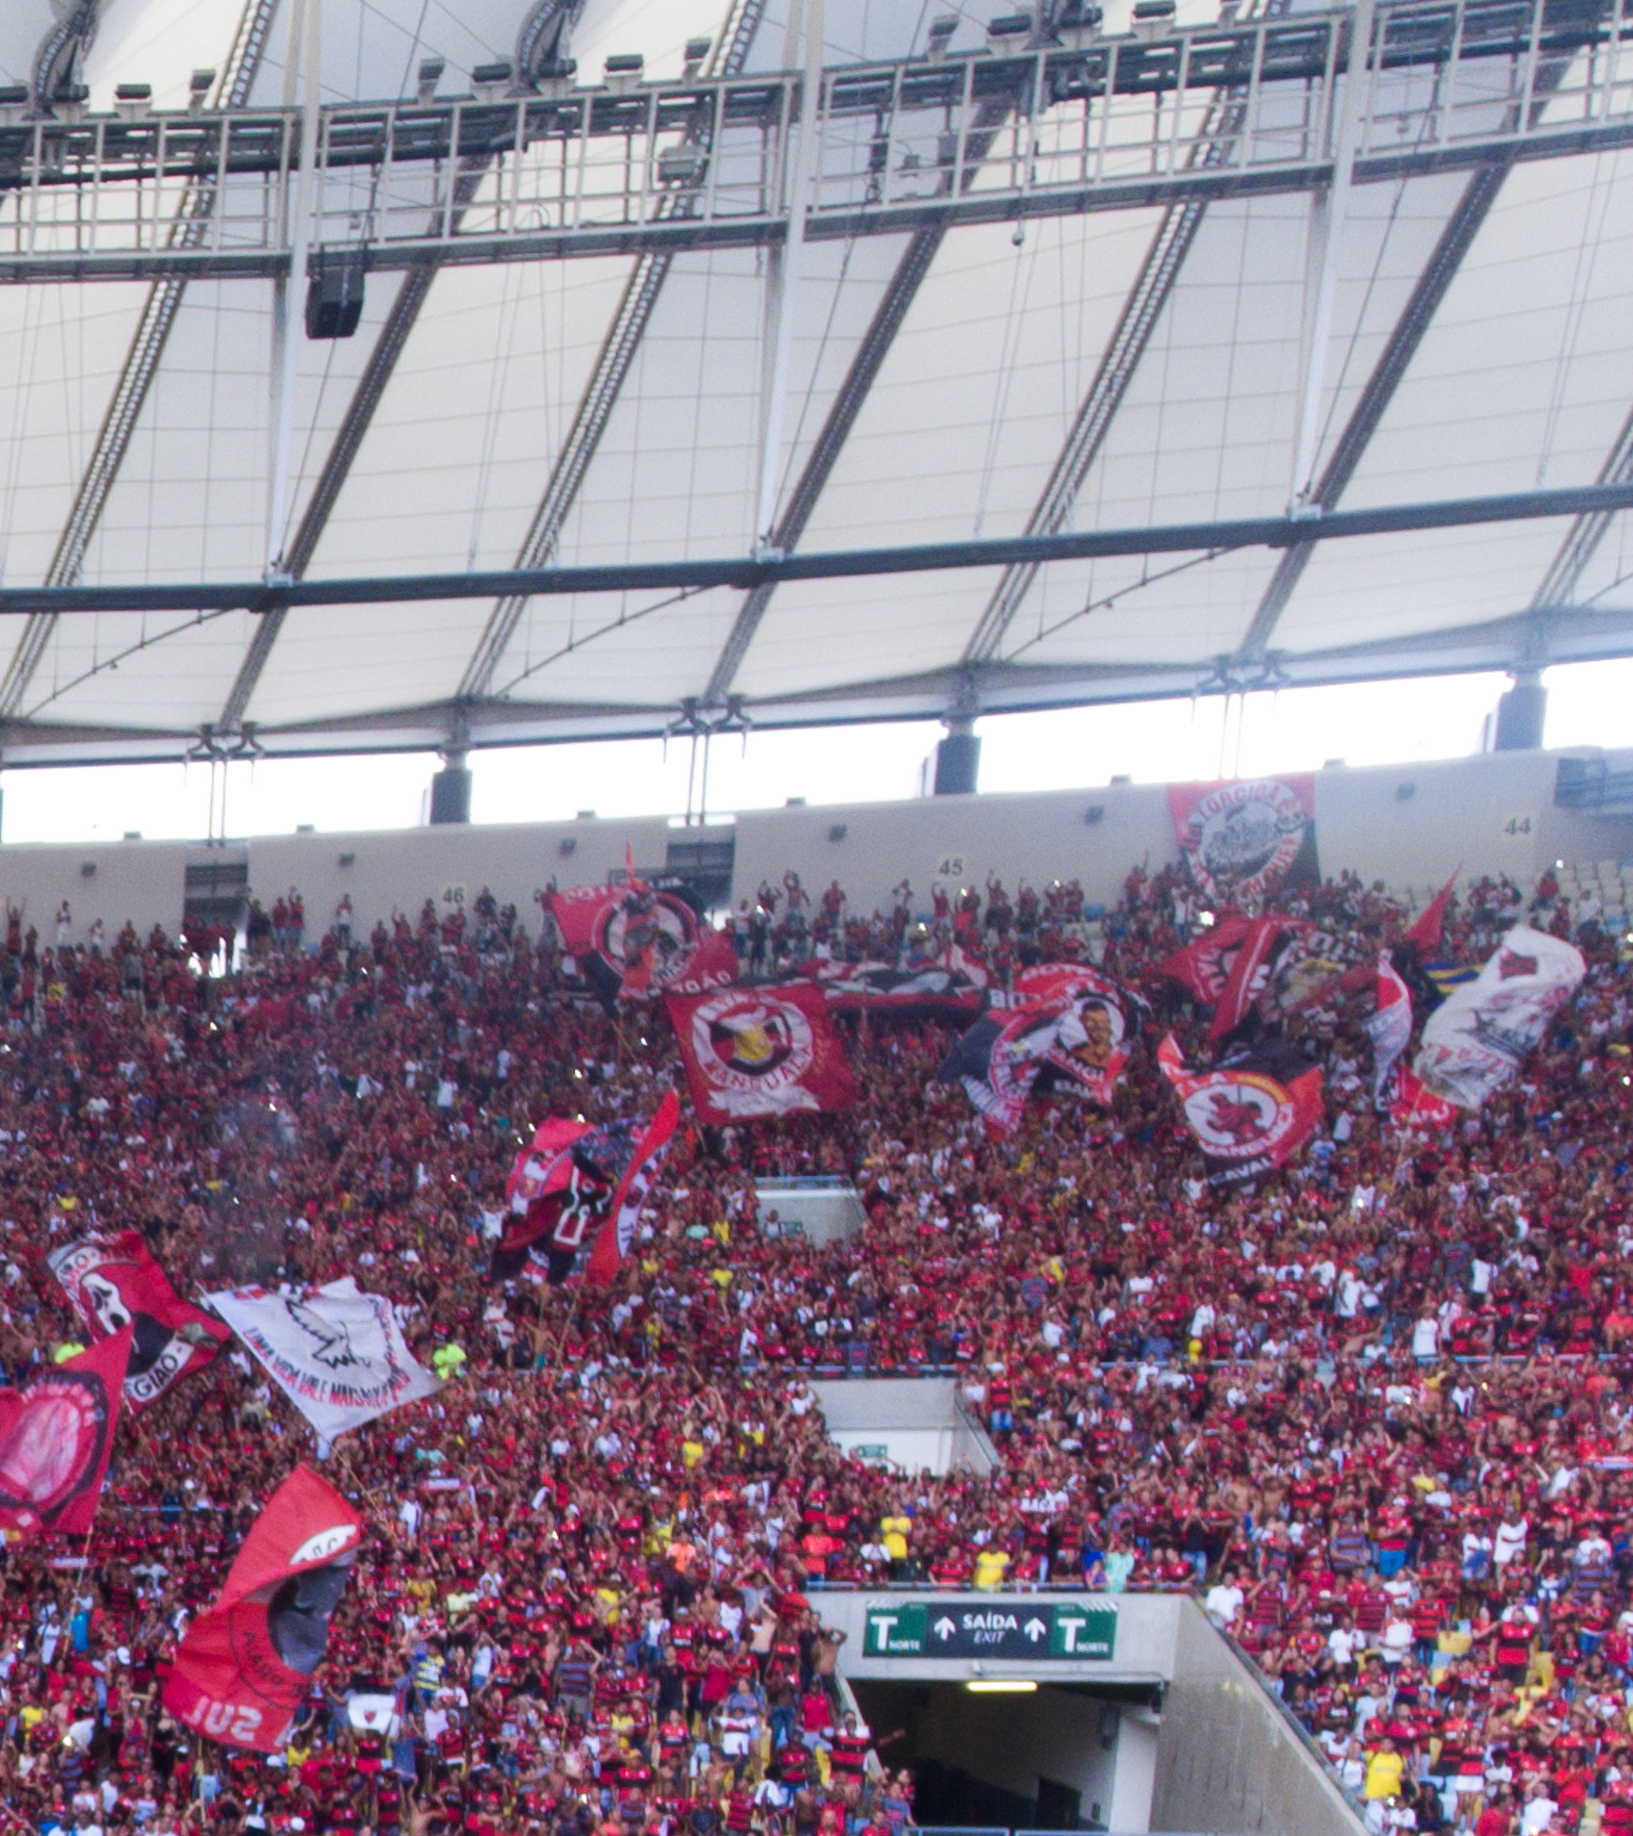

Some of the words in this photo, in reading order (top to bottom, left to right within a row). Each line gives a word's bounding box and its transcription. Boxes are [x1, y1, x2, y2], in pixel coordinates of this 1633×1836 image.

[1505, 817, 1531, 835] 44
[939, 859, 963, 876] 45
[443, 887, 464, 904] 46
[962, 1612, 1018, 1631] SAÍDA
[973, 1631, 1006, 1644] EXIT
